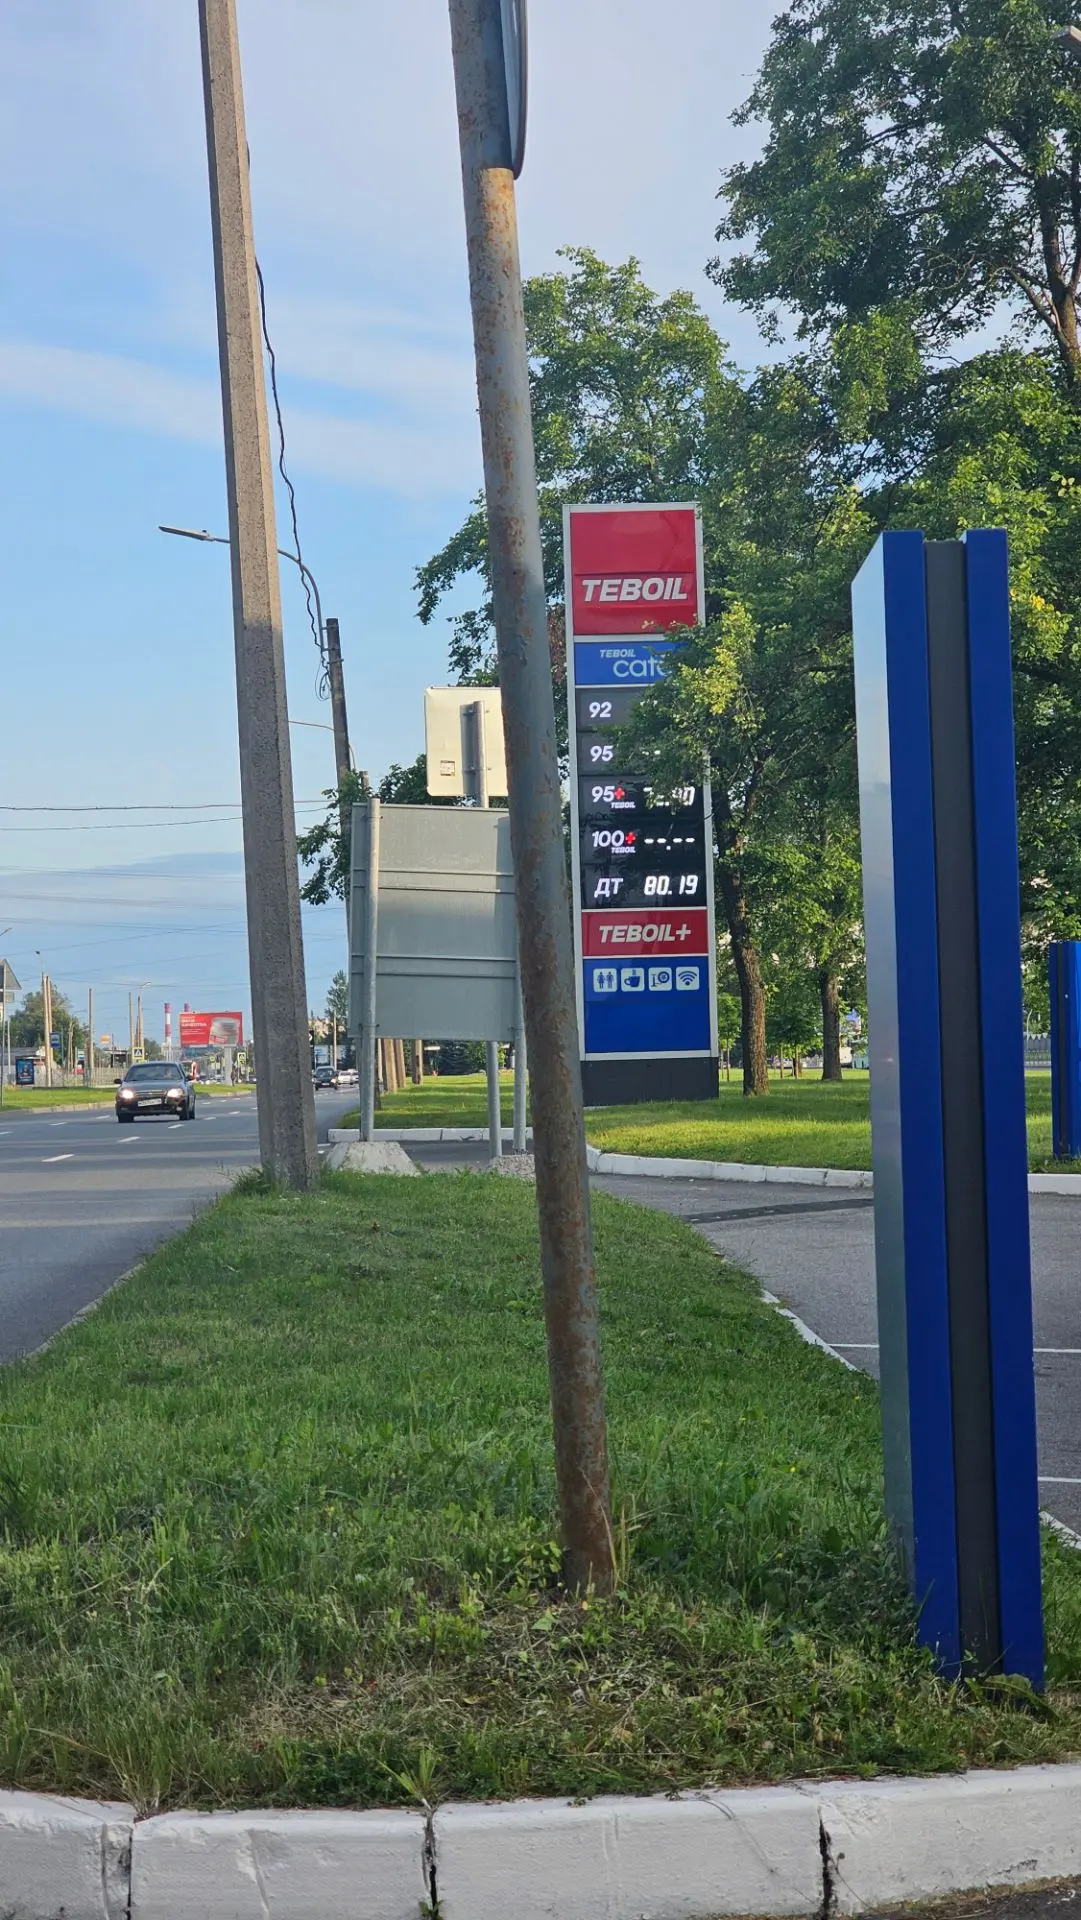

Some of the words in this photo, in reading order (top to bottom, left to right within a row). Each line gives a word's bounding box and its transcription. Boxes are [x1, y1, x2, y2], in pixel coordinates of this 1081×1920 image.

[582, 577, 687, 601] TEBOIL
[599, 649, 636, 658] TEBOIL
[589, 702, 612, 718] 92
[590, 745, 613, 762] 95
[594, 877, 623, 898] ДТ
[644, 875, 698, 895] 80.19
[599, 923, 691, 943] TEBOIL+
